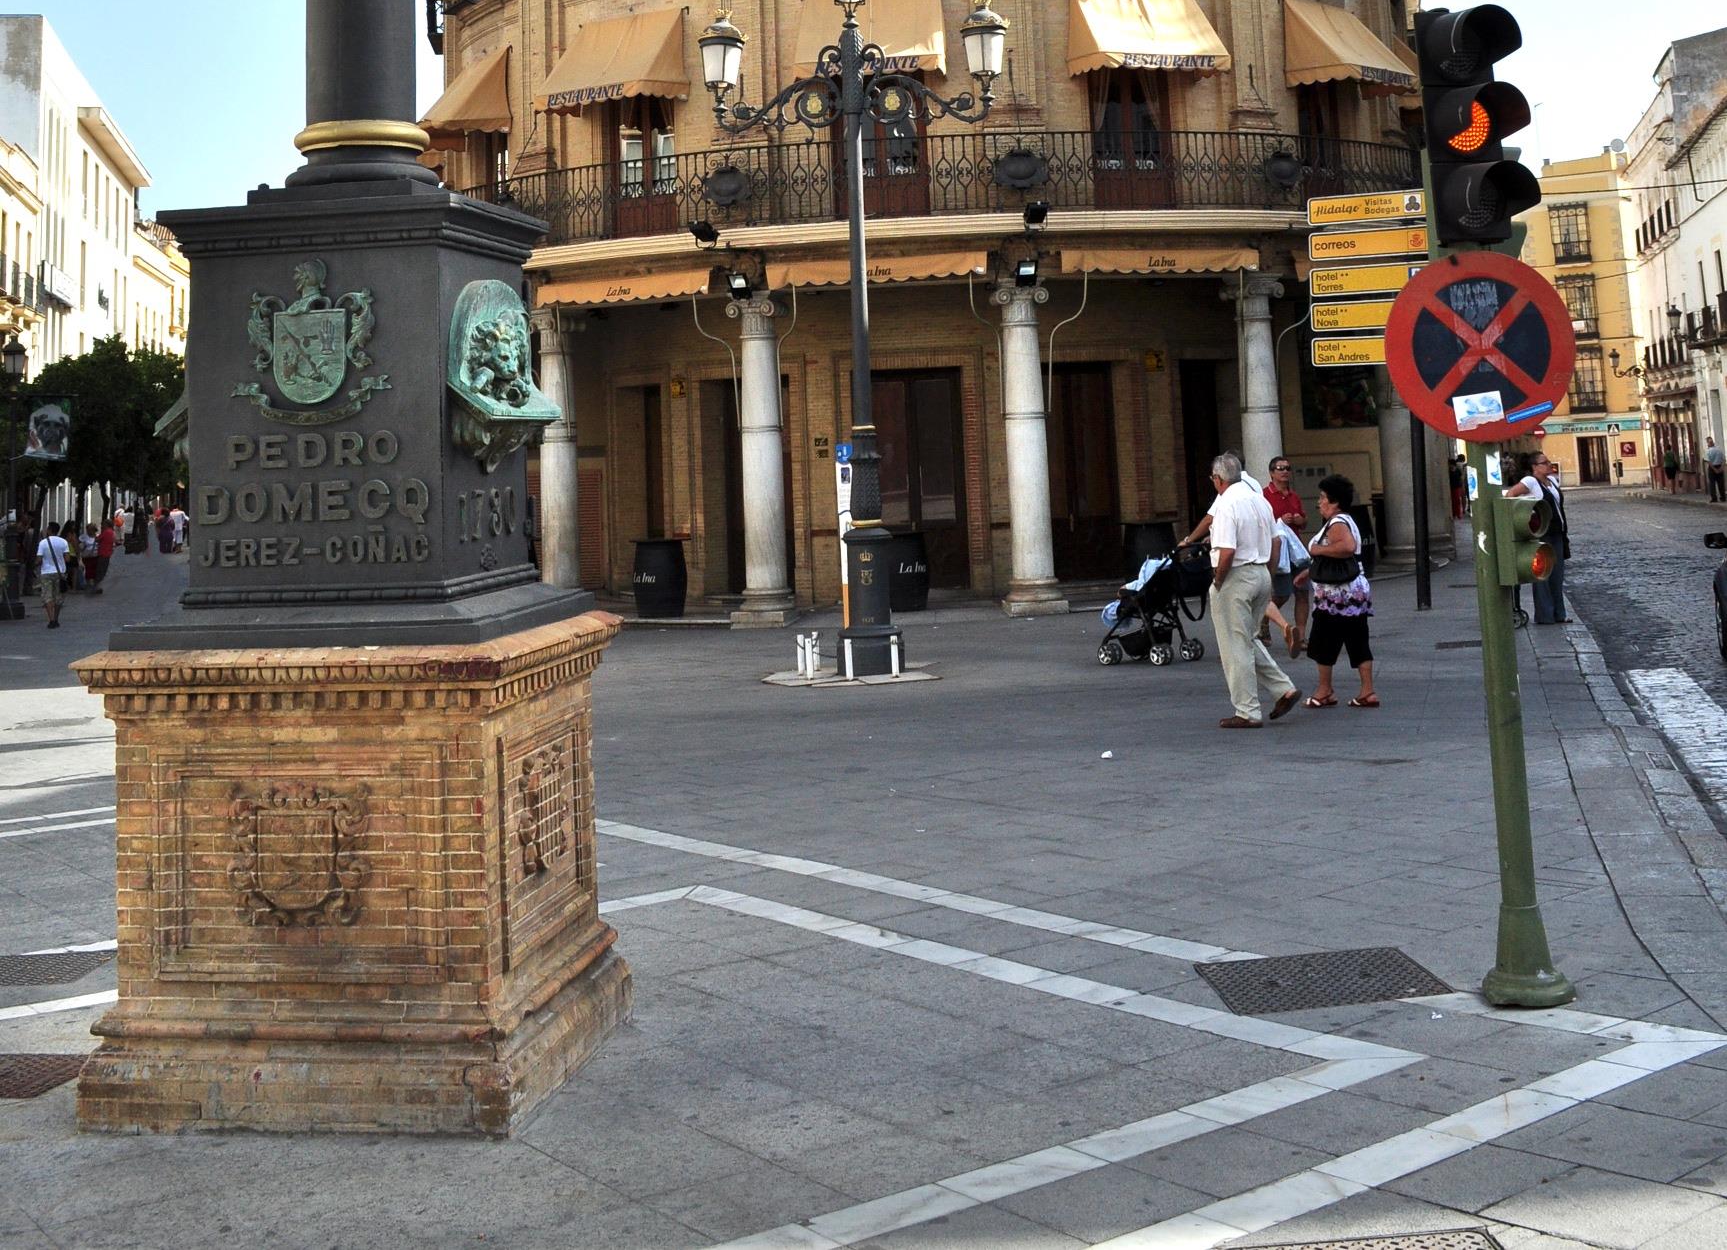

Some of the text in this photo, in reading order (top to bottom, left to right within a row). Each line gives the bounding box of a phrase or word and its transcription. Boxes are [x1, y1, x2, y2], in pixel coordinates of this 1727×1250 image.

[1123, 53, 1216, 68] RESTAURANTE
[548, 83, 625, 108] RESTAURANTE
[1364, 198, 1393, 207] Visitas
[1314, 204, 1360, 217] Hidalgo
[1364, 207, 1400, 215] Bodegas
[1314, 240, 1357, 251] correos
[1147, 255, 1176, 267] La Ina
[874, 265, 892, 277] Ina
[1316, 272, 1338, 282] hotel
[606, 285, 632, 297] La Ina
[1316, 283, 1344, 292] Torres
[1316, 308, 1338, 317] hotel
[1316, 319, 1339, 327] Nova
[1317, 343, 1340, 352] hotel
[1317, 352, 1370, 363] San Andres
[224, 429, 398, 470] PEDRO
[198, 478, 429, 525] DOMECQ
[898, 562, 913, 574] La
